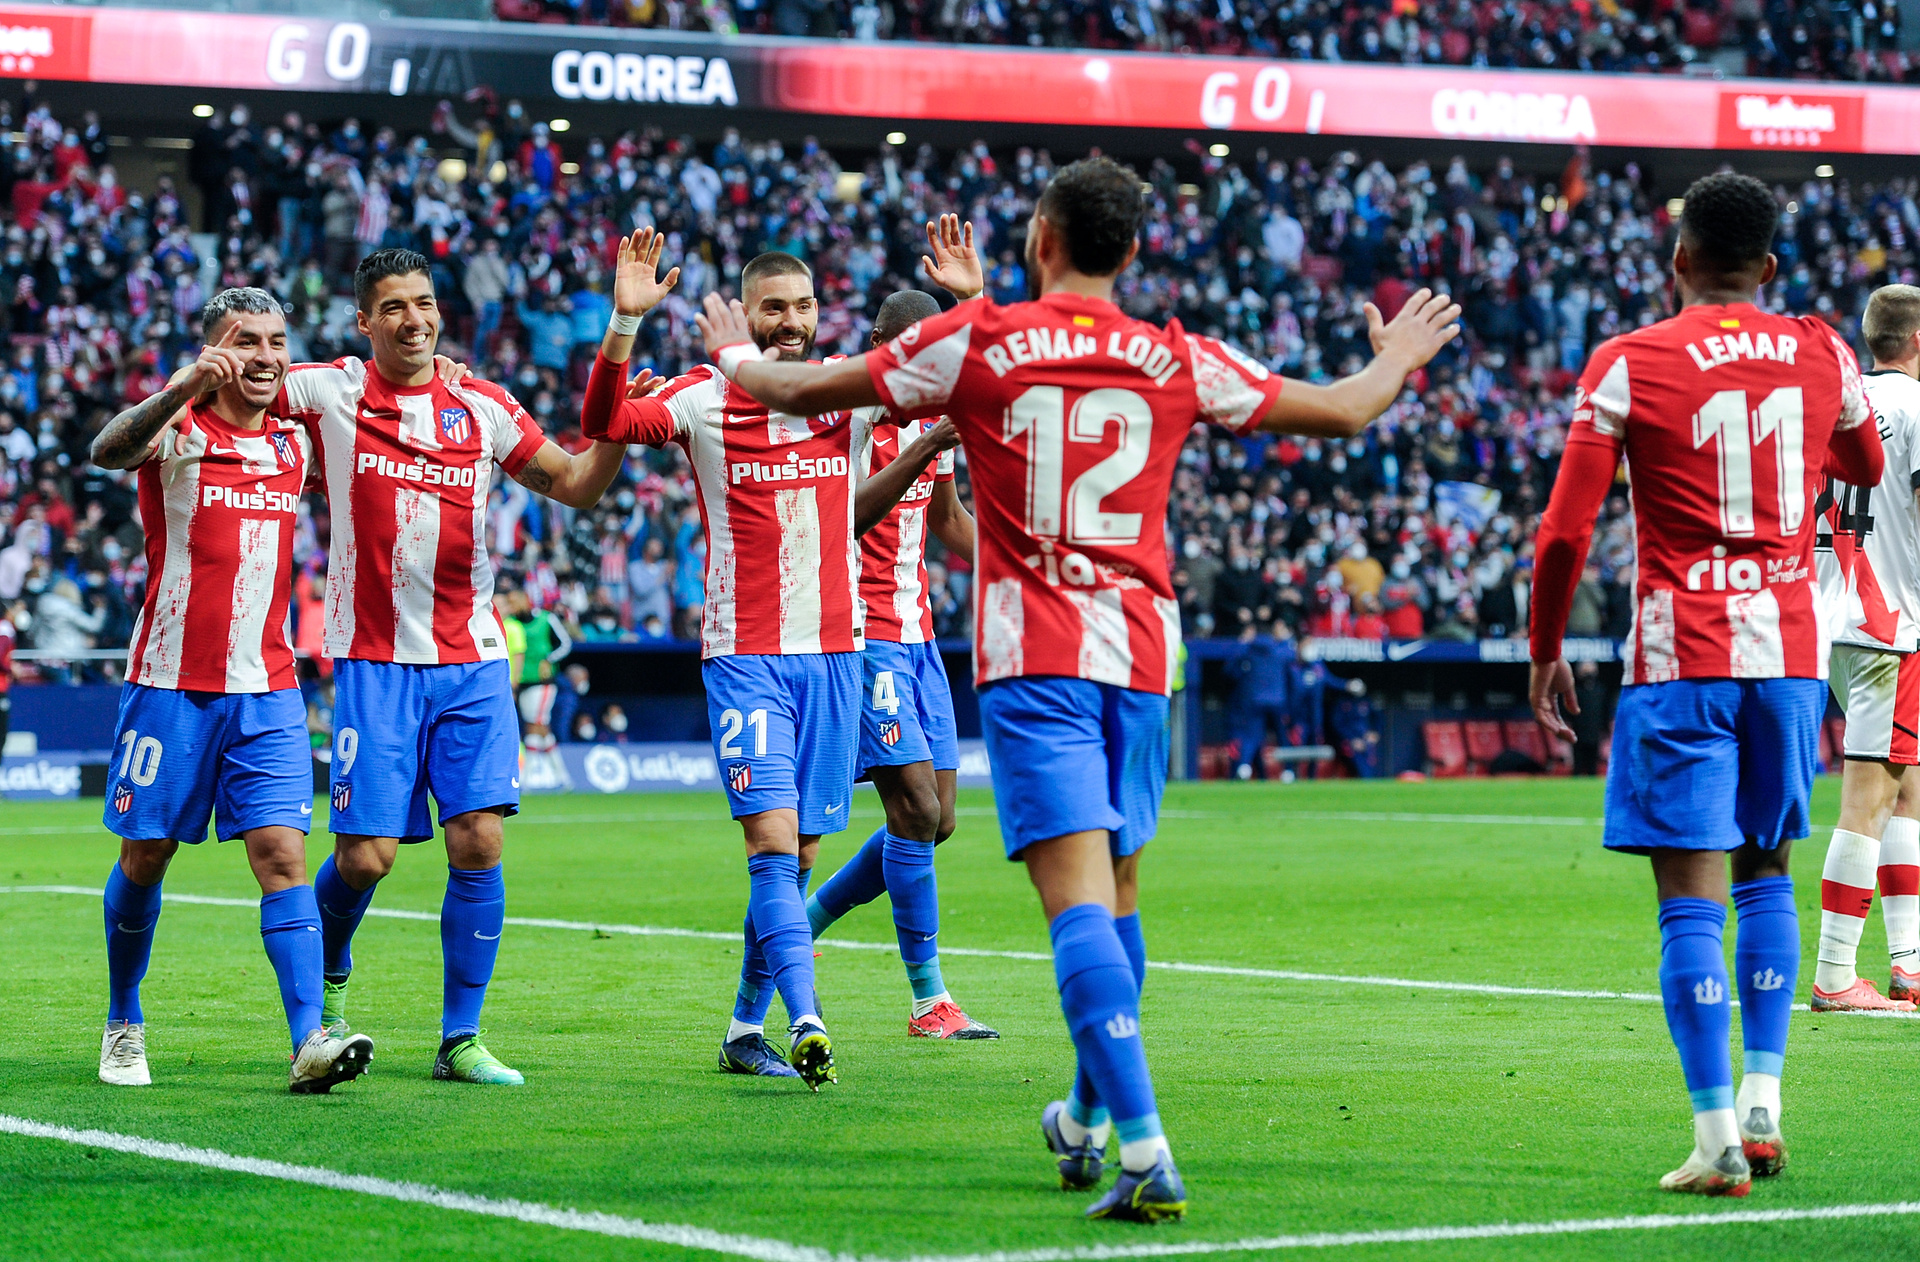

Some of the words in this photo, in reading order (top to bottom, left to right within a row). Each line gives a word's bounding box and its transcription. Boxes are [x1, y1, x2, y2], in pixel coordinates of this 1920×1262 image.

[552, 50, 739, 105] CORREA
[1431, 88, 1596, 138] CORREA
[983, 327, 1097, 378] RENAN
[1107, 331, 1181, 388] LODI
[1685, 331, 1798, 372] LEMAR
[357, 452, 475, 487] Plus500
[731, 451, 847, 484] Plus500
[1002, 385, 1153, 546] 12
[1692, 387, 1805, 538] 11
[1687, 545, 1762, 590] ria
[872, 671, 900, 715] 4
[119, 729, 163, 787] 10
[337, 727, 359, 777] 9
[720, 708, 767, 760] 21
[628, 752, 716, 785] LaLiga
